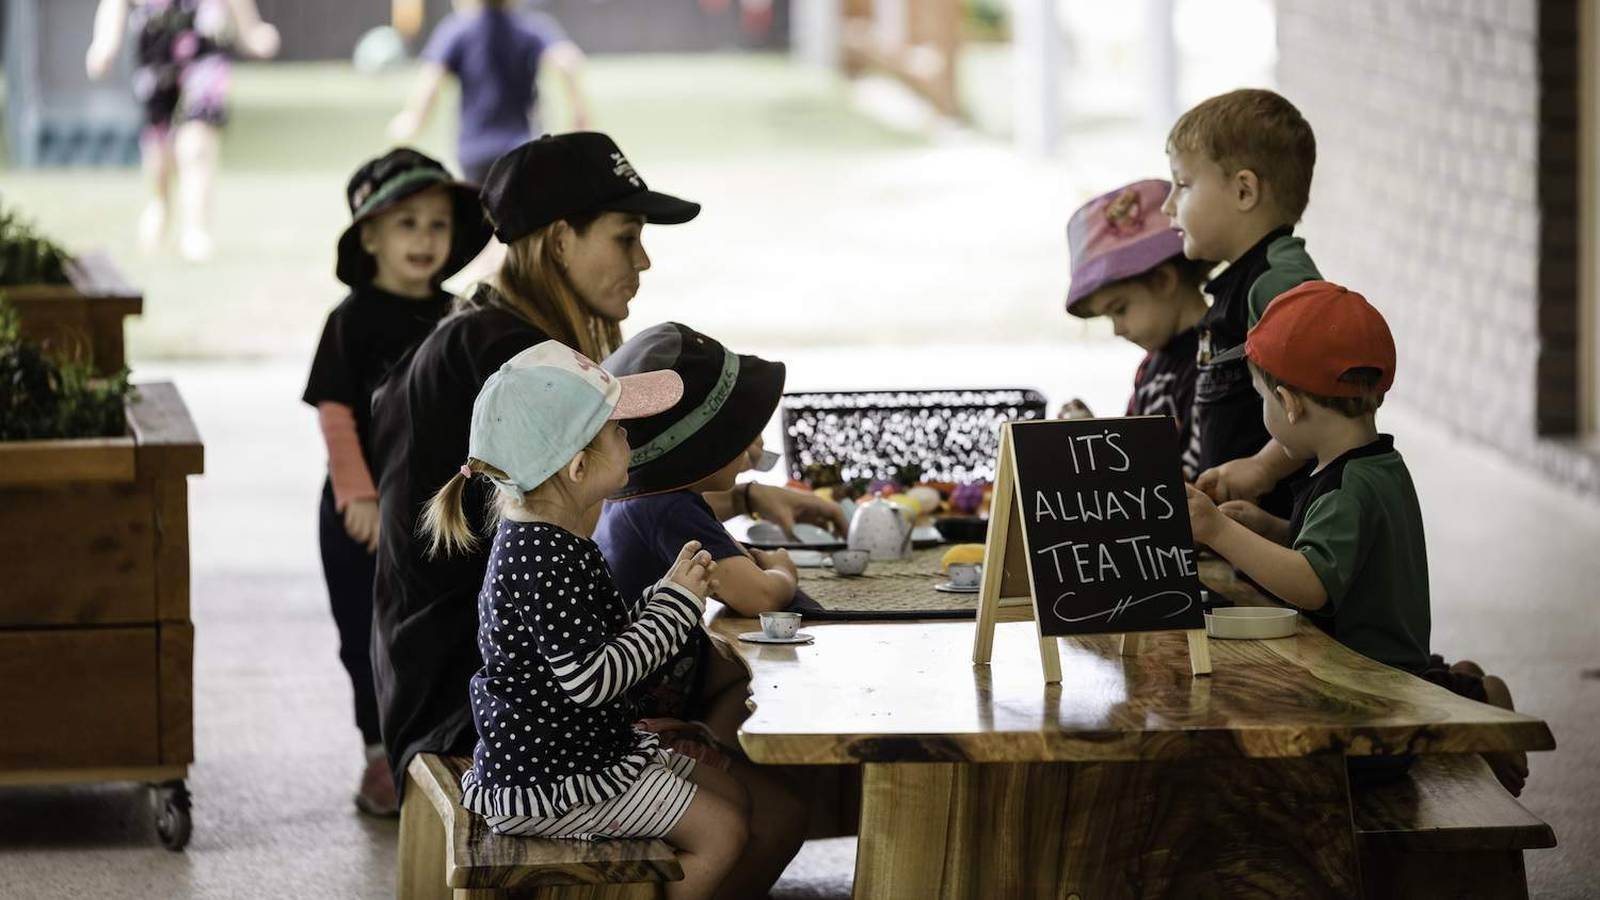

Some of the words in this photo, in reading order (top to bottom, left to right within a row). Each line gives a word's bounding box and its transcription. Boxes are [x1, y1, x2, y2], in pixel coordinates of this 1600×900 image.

[1067, 429, 1131, 474] IT'S
[1035, 484, 1174, 523] ALWAYS
[1037, 541, 1121, 584] TEA
